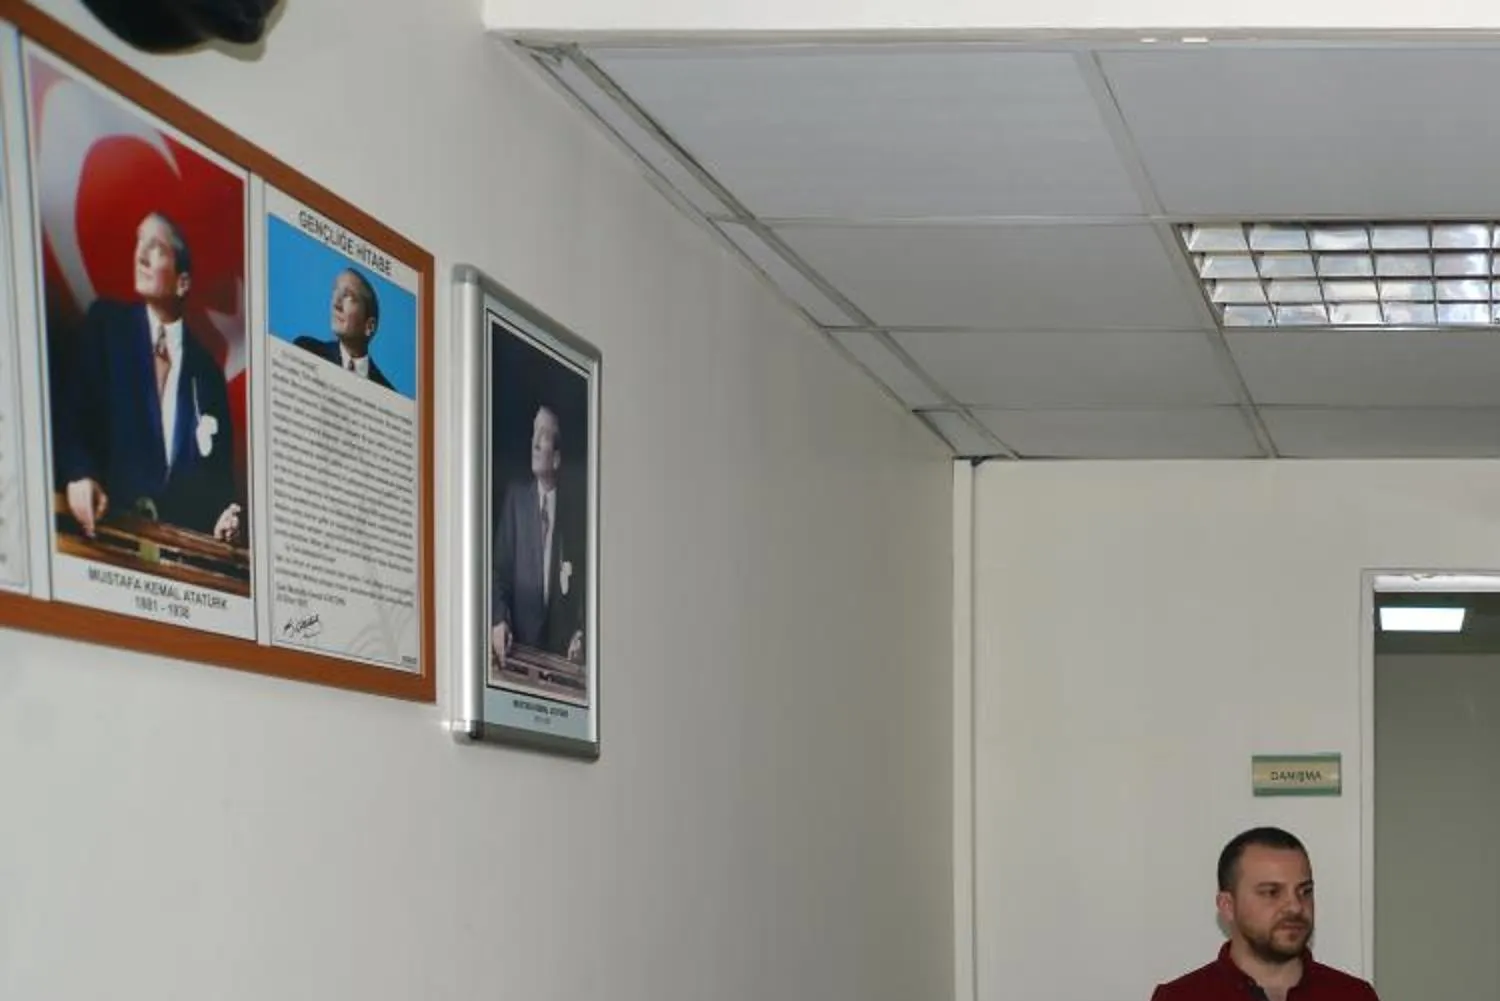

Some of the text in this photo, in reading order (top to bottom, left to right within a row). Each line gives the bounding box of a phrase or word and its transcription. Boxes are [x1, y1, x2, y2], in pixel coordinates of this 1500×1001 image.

[356, 240, 393, 276] HİTABE
[88, 564, 228, 609] MUSTAFA KEMAL ATATÜRK
